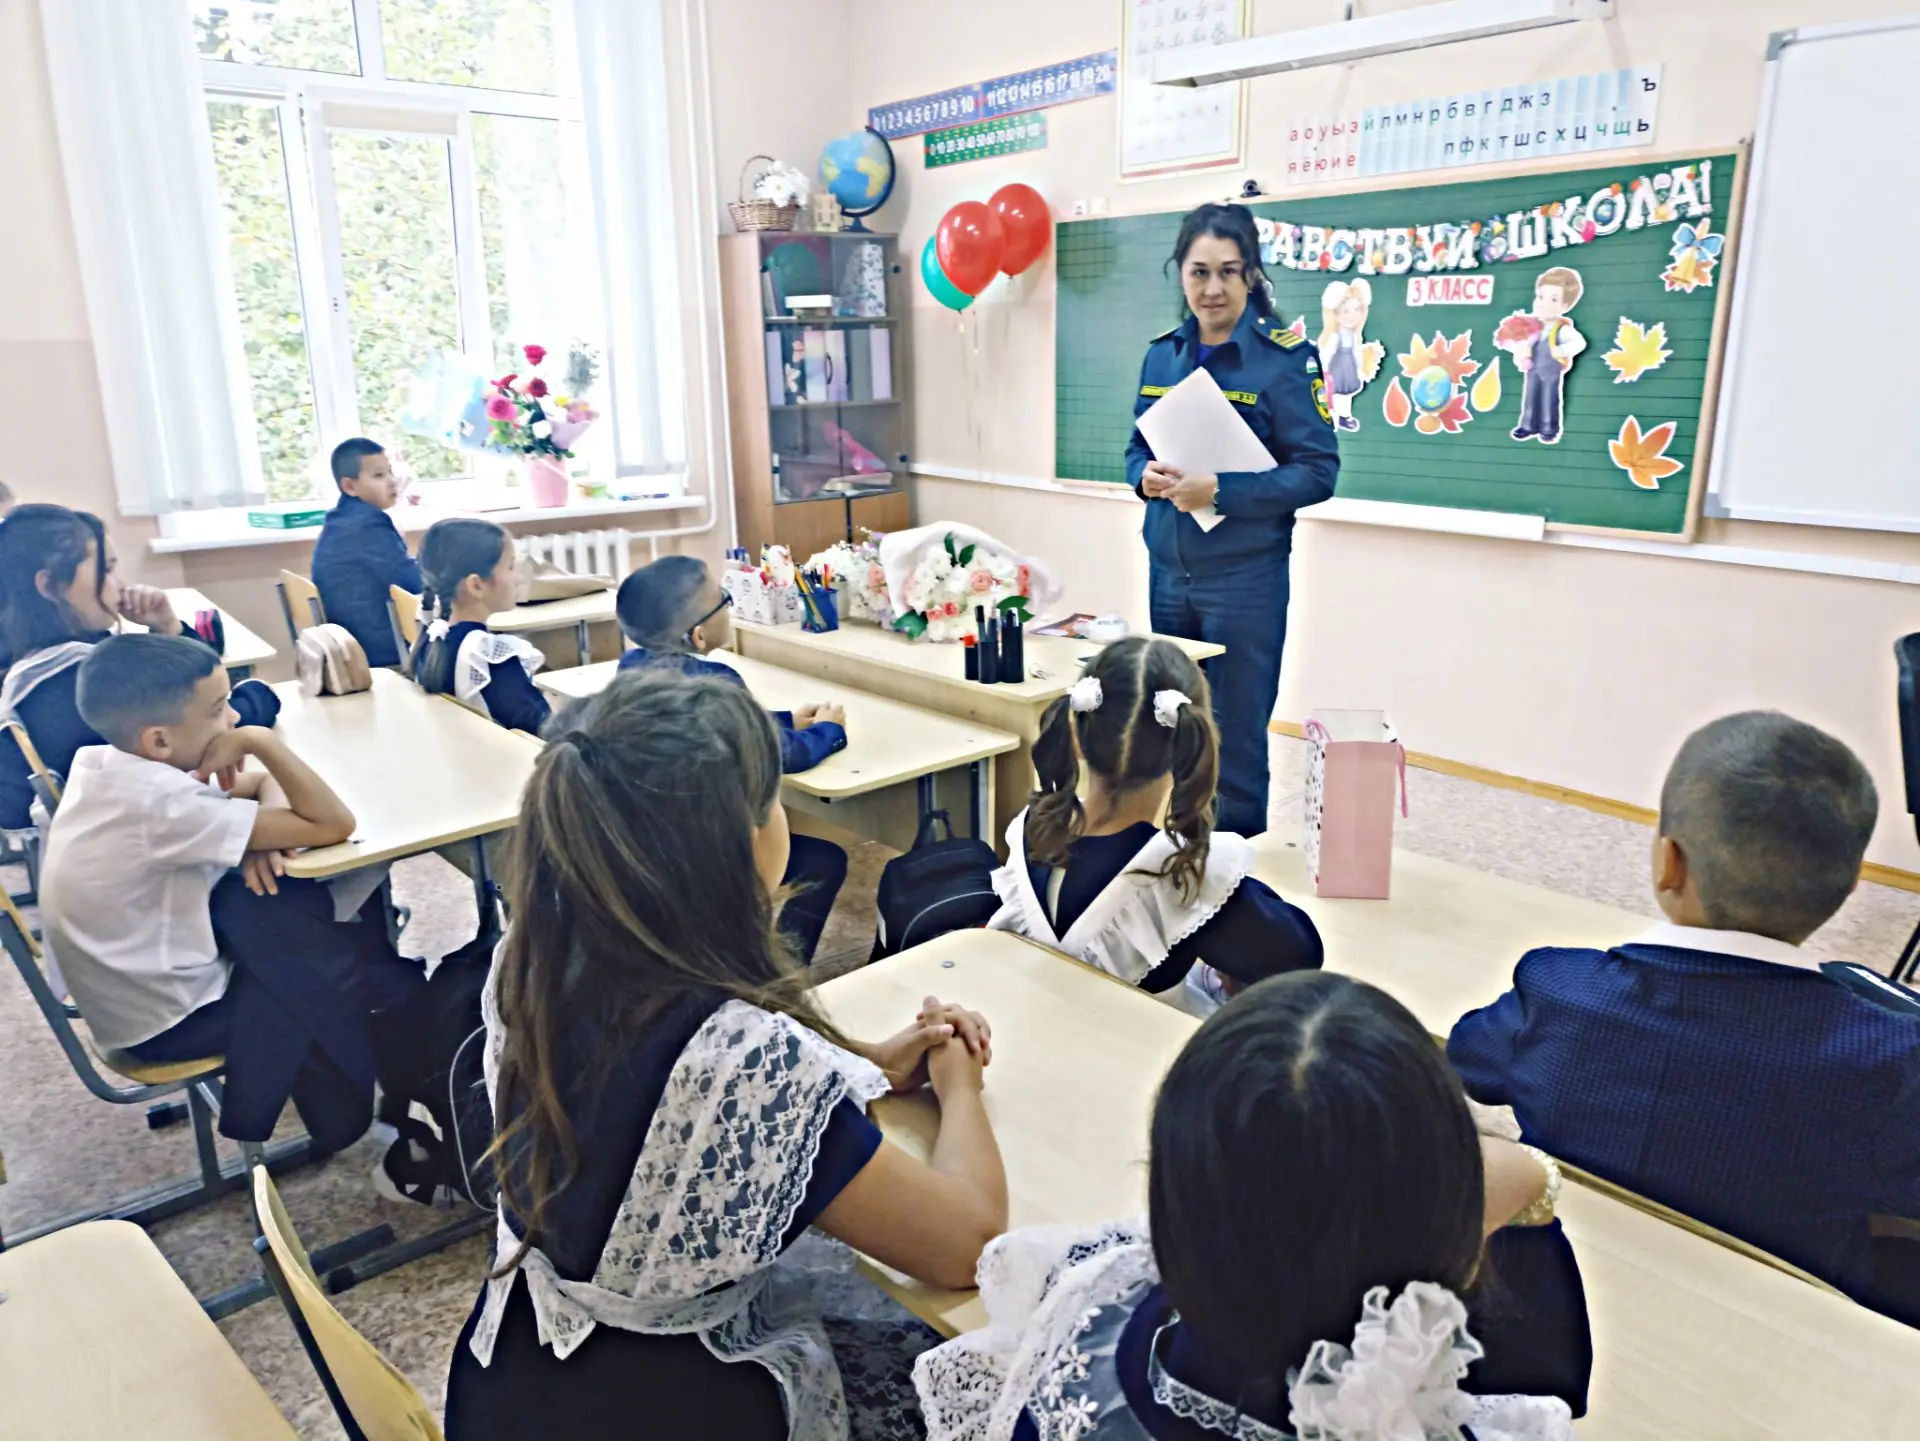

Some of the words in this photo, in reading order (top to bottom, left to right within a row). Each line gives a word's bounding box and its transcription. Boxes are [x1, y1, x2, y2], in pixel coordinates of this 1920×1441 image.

[1289, 130, 1298, 142] а
[1304, 128, 1313, 140] о
[1319, 127, 1328, 142] у
[1332, 124, 1345, 136] ы
[1395, 113, 1408, 125] м
[1413, 111, 1423, 122] н
[1429, 109, 1440, 125] р
[1447, 102, 1458, 119] б
[1465, 104, 1475, 117] в
[1484, 101, 1493, 114] г
[1500, 98, 1514, 114] д
[1519, 95, 1534, 109] ж
[1540, 92, 1551, 107] з
[1641, 77, 1657, 92] ъ
[1287, 162, 1297, 174] я
[1314, 158, 1328, 170] ю
[1331, 157, 1341, 168] и
[1346, 154, 1356, 167] е
[1444, 142, 1455, 155] п
[1459, 136, 1475, 156] ф
[1480, 139, 1490, 150] к
[1498, 135, 1509, 148] т
[1514, 132, 1530, 147] ш
[1535, 131, 1547, 144] с
[1555, 129, 1567, 142] х
[1574, 125, 1588, 141] ц
[1595, 123, 1607, 136] ч
[1613, 121, 1631, 136] щ
[1636, 118, 1650, 133] ь
[1502, 160, 1712, 260] ШКОЛА!
[1413, 280, 1422, 303] 3
[1427, 278, 1490, 301] КЛАСС
